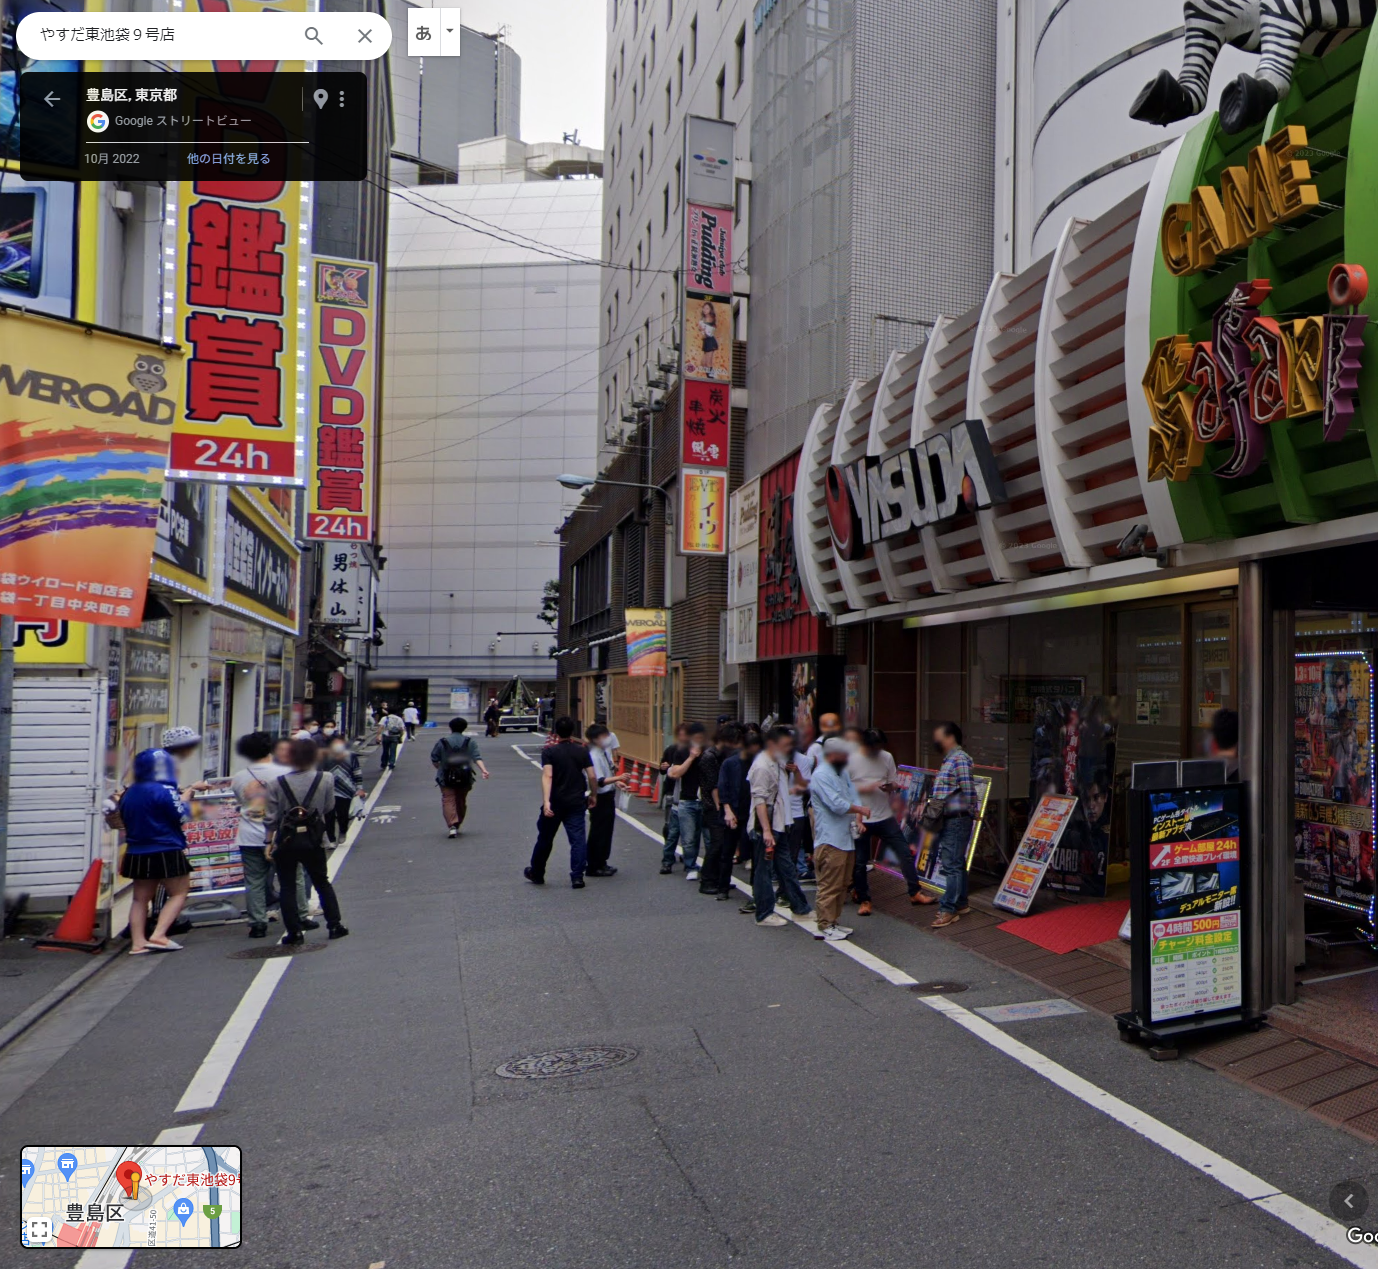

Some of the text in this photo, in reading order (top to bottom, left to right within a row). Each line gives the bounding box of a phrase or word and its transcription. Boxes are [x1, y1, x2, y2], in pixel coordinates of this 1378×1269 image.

[1161, 125, 1319, 277] GAME
[695, 211, 717, 289] Pudding
[317, 306, 366, 512] DVD鑑賞
[708, 387, 726, 424] 炭火
[195, 439, 269, 470] 24h
[844, 420, 1000, 545] YASUDA
[314, 515, 362, 537] 24h
[699, 502, 717, 535] イヴ
[1174, 840, 1237, 854] ゲーム部屋 24h
[1159, 931, 1232, 950] チャージ料金設定
[1166, 922, 1192, 935] 4時間
[1193, 918, 1220, 931] 500円
